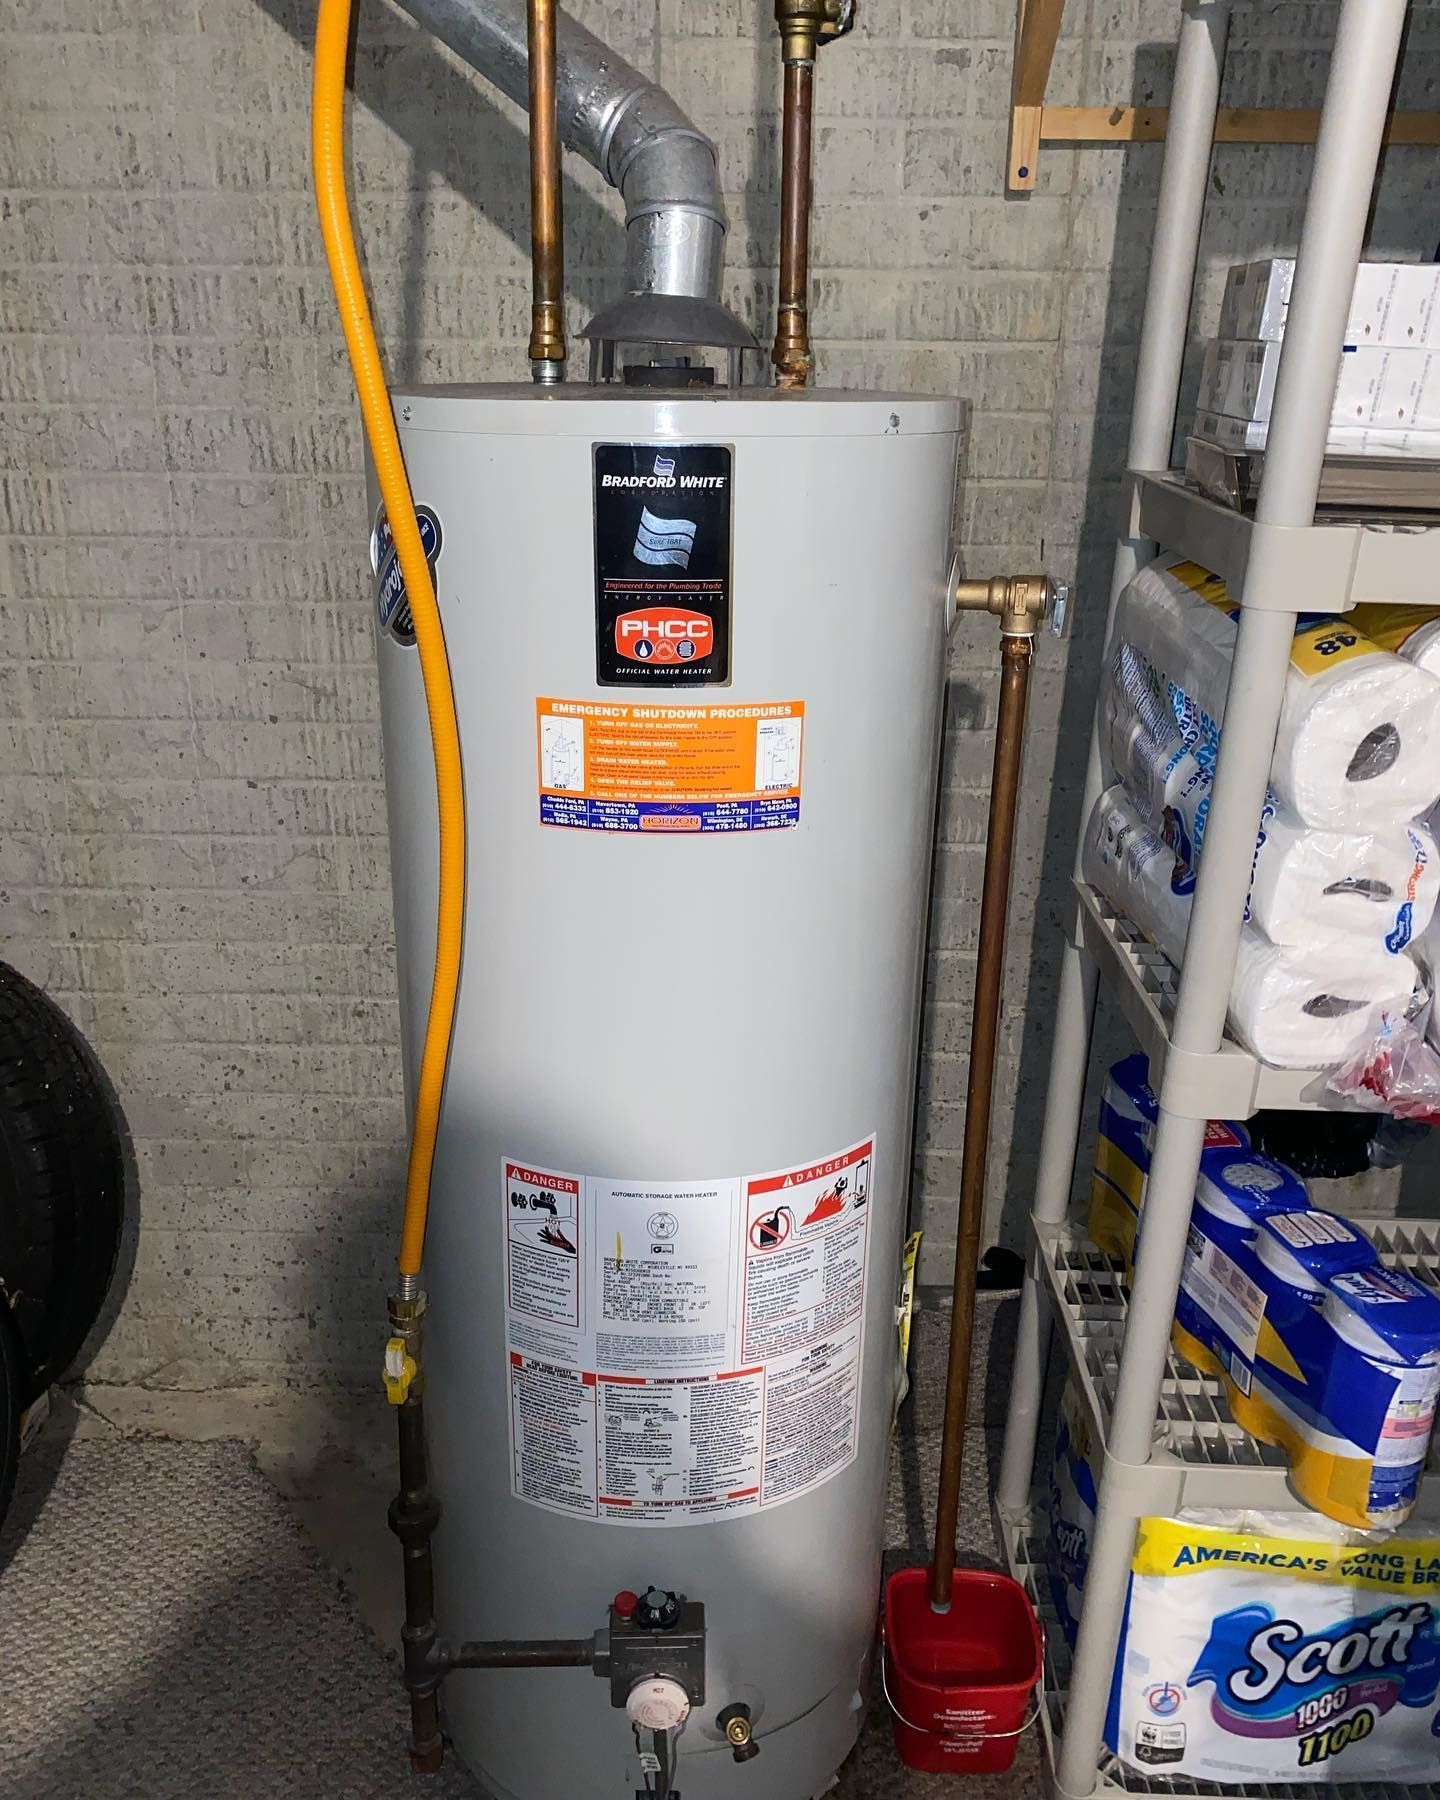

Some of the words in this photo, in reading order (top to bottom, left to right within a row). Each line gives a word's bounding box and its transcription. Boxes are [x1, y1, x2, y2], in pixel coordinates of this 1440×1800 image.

[602, 474, 676, 488] BRADFORD
[680, 475, 724, 488] WHITE
[605, 582, 643, 590] Engineered
[656, 582, 667, 590] the
[668, 583, 700, 591] Plumbing
[621, 620, 709, 638] PHCC
[1313, 635, 1358, 656] 48
[615, 667, 650, 675] OFFICIAL
[551, 703, 628, 718] EMERGENCY
[632, 708, 706, 719] SHUTDOWN
[710, 706, 792, 719] PROCEDURES
[765, 782, 793, 790] ELECTRIC
[724, 791, 762, 799] EMERGENCY
[642, 817, 699, 825] HORIZON
[796, 1156, 849, 1183] DANGER
[523, 1172, 573, 1191] DANGER
[611, 1191, 644, 1199] AUTOMATIC
[526, 1363, 538, 1371] READ
[538, 1366, 555, 1377] BEFORE
[540, 1362, 553, 1370] YOUR
[554, 1366, 572, 1376] SAFETY
[676, 1376, 710, 1384] INSTRUCTIONS
[1173, 1546, 1329, 1572] AMERICA'S
[1341, 1566, 1405, 1584] VALUE
[1230, 1602, 1430, 1702] Scott
[1297, 1687, 1348, 1728] 1000
[1300, 1708, 1374, 1766] 1100
